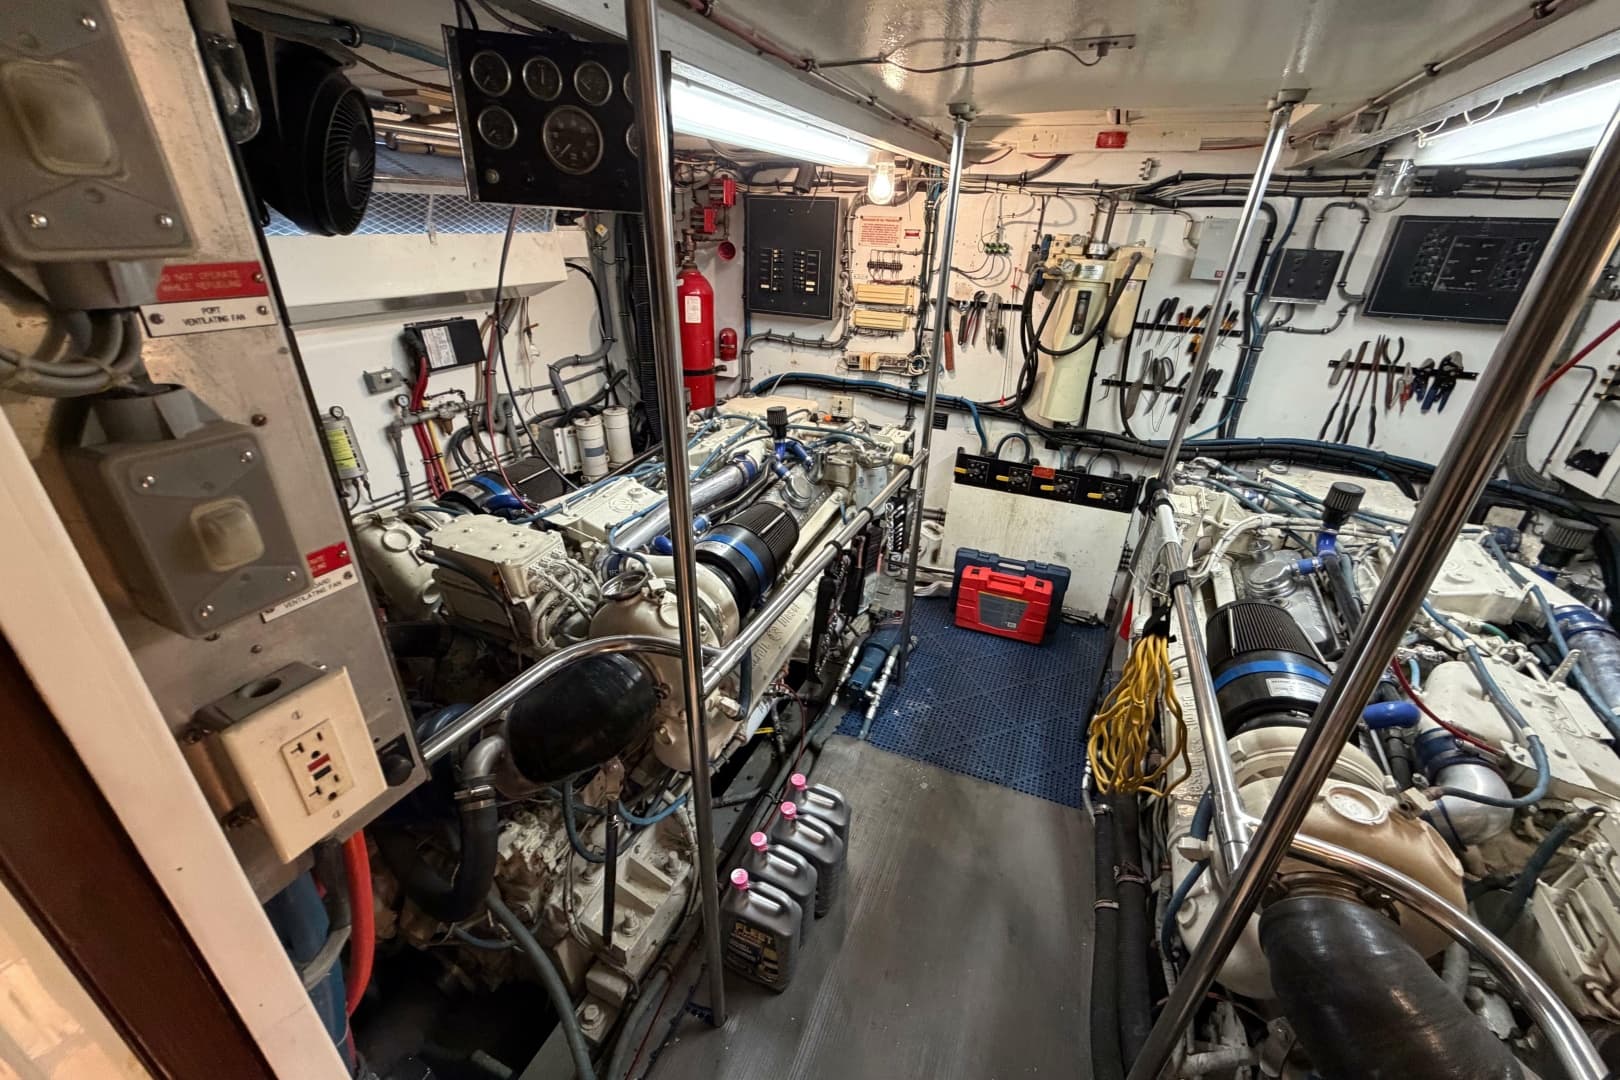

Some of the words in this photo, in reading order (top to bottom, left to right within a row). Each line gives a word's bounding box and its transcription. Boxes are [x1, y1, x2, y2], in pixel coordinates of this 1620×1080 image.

[201, 306, 220, 315] PORT
[182, 315, 229, 326] VENTILATING
[231, 313, 246, 322] FAN
[284, 586, 326, 608] VENTILATING
[328, 580, 342, 590] FAN
